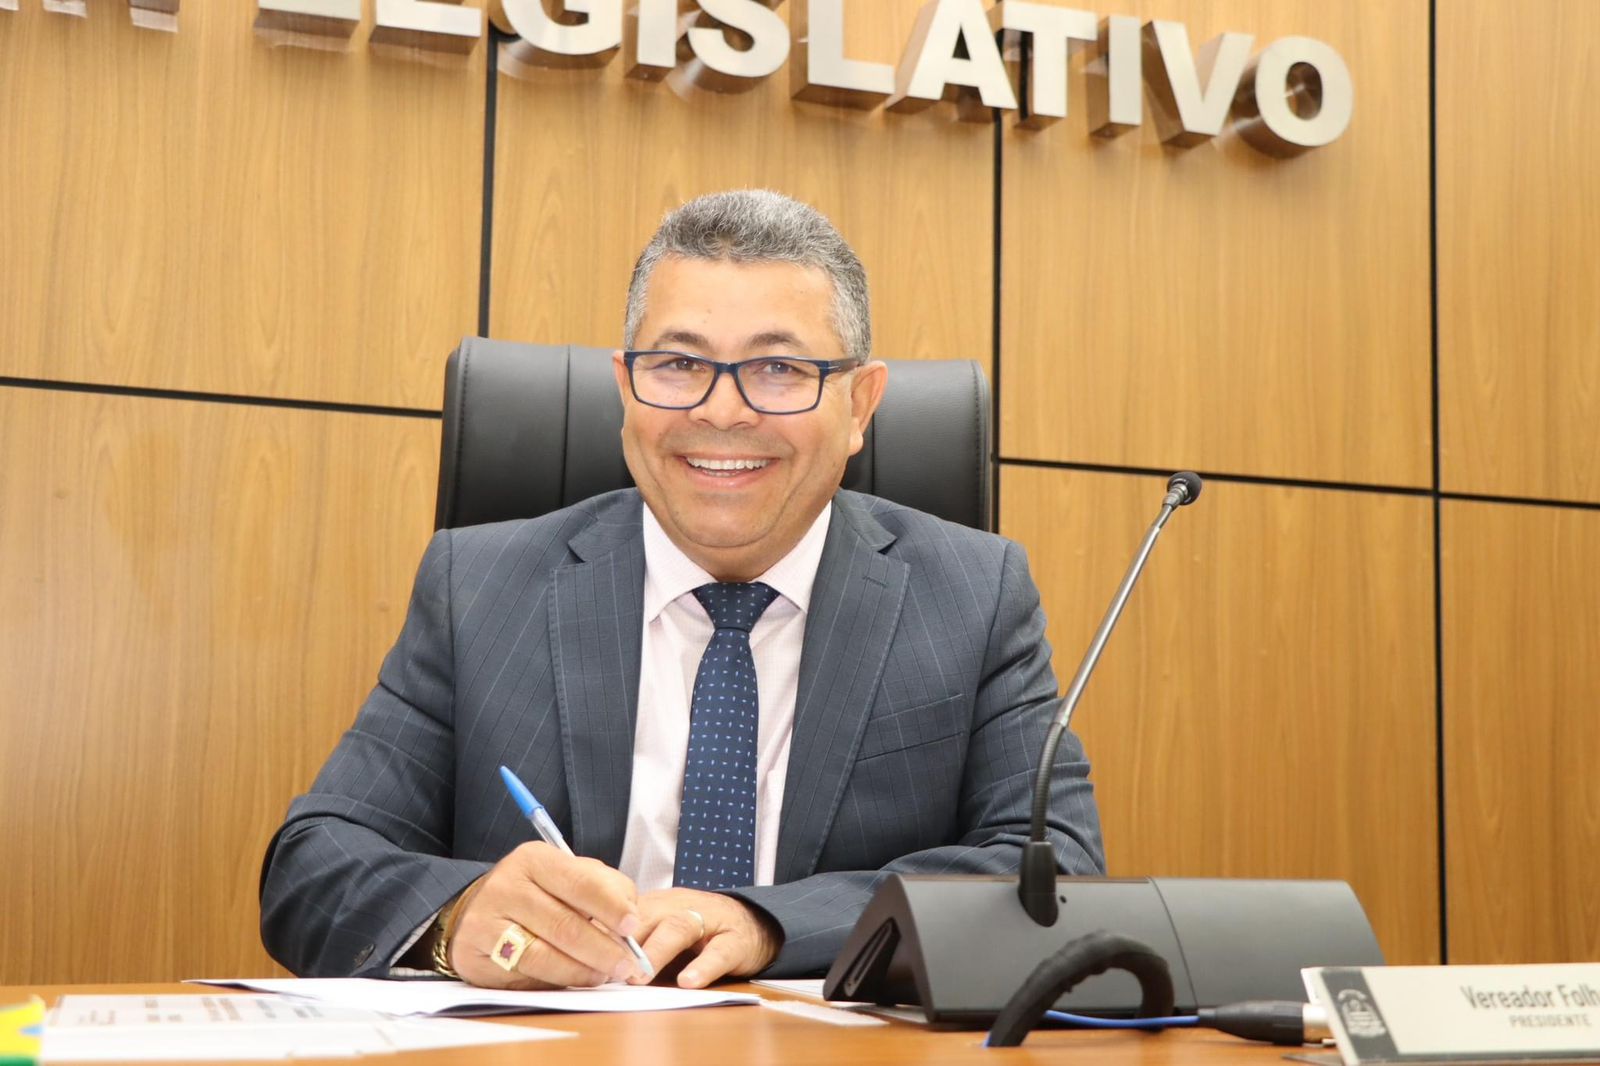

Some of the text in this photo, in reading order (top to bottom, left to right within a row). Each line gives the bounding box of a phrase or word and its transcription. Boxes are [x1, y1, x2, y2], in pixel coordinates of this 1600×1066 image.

[259, 0, 1353, 147] GISLATIVO
[1460, 984, 1555, 1009] Vereador
[1509, 1013, 1592, 1028] PRESIDENTE
